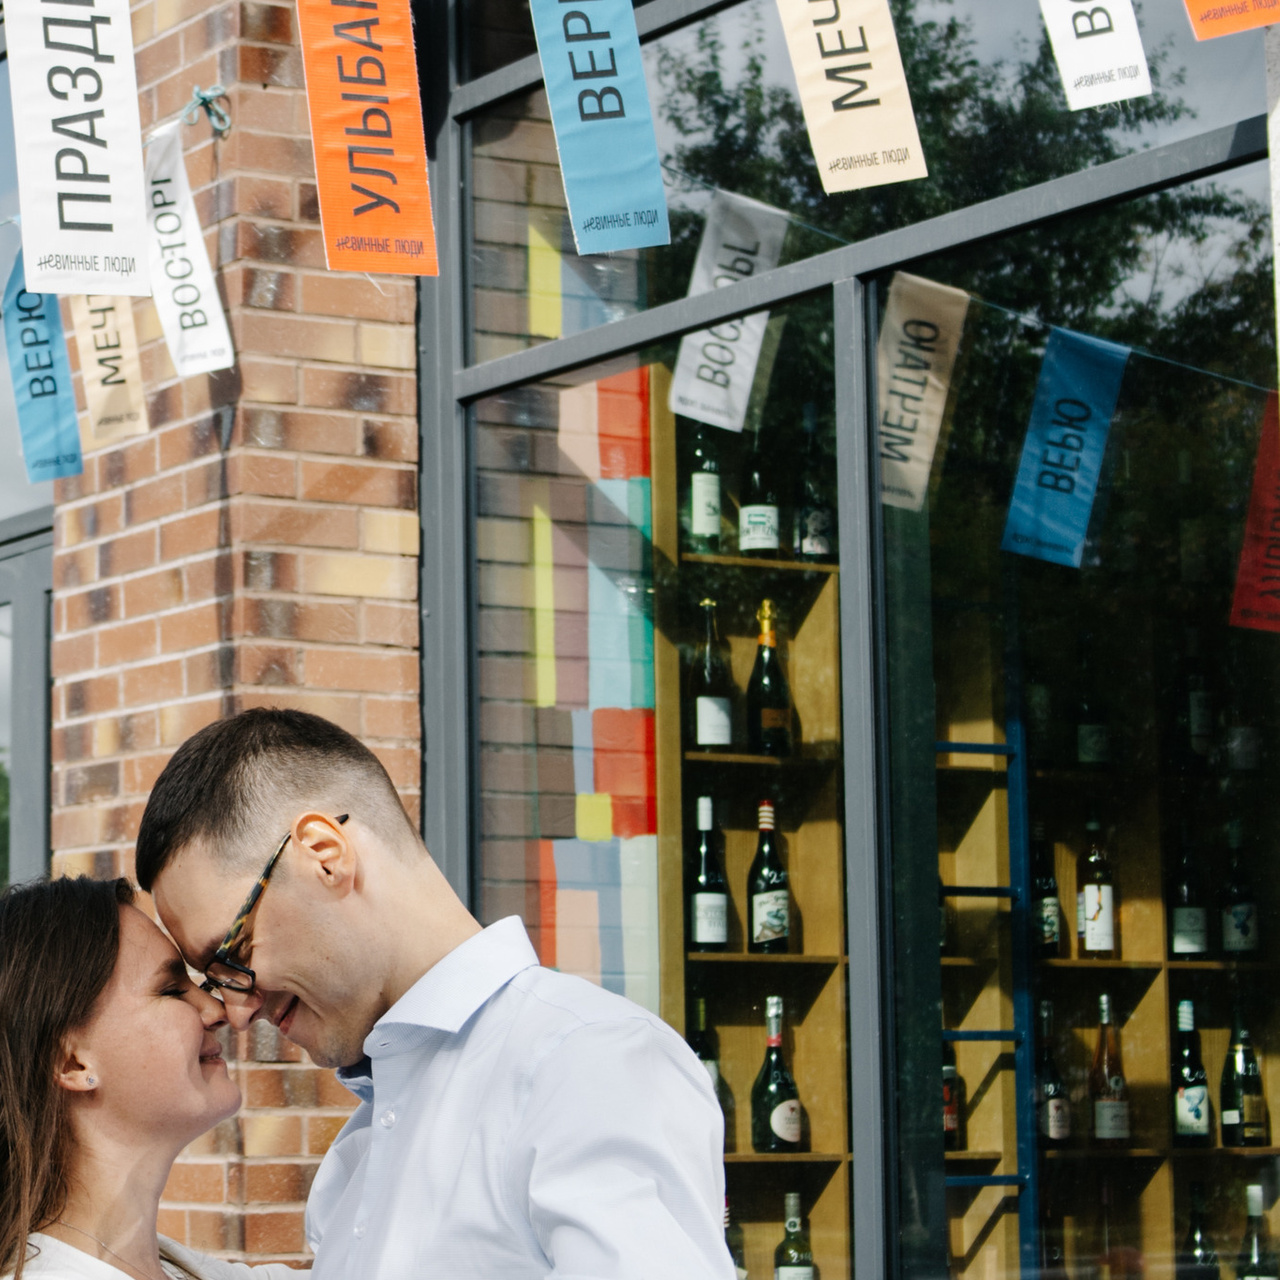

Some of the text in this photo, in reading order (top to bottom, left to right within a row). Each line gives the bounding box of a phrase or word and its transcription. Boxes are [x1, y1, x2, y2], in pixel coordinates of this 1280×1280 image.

[1117, 63, 1141, 83] ЛЮДИ
[881, 147, 911, 166] ЛЮДИ
[633, 208, 660, 228] ЛЮДИ
[394, 237, 426, 259] ЛЮДИ
[103, 255, 137, 277] ЛЮДИ
[15, 288, 58, 400] ВЕРЮ
